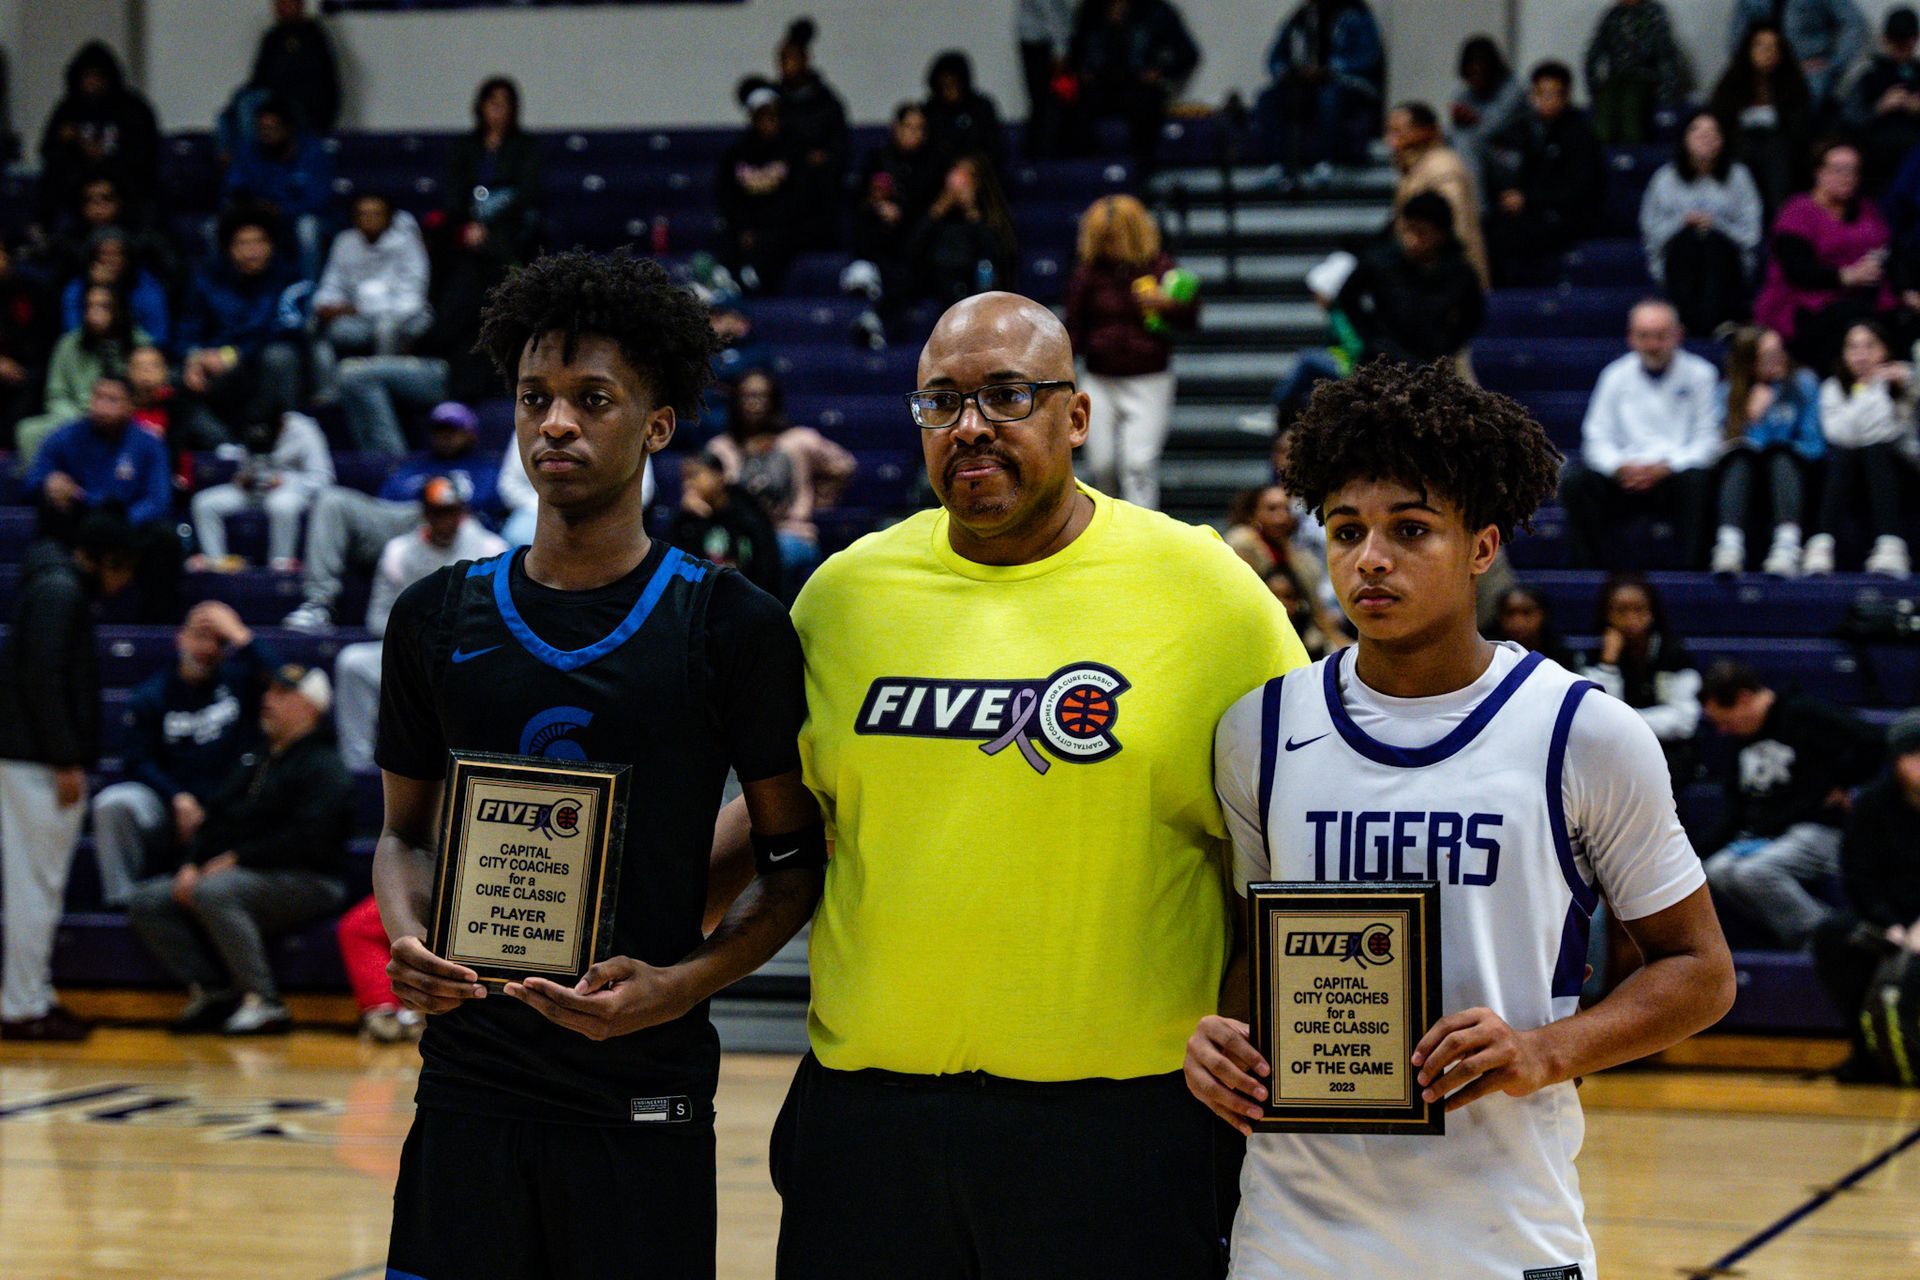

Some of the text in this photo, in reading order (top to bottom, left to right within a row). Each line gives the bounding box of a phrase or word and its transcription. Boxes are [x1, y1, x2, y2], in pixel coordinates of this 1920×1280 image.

[1062, 674, 1082, 686] CURE
[1082, 674, 1113, 688] CLASSIC
[1048, 690, 1058, 704] FOR
[865, 686, 1013, 731] FIVE
[1045, 704, 1058, 736] COACHES
[1056, 736, 1072, 747] CITY
[1074, 741, 1104, 750] CAPITAL
[480, 802, 537, 824] FIVE
[500, 844, 552, 859] CAPITAL
[1306, 811, 1504, 886] TIGERS
[479, 856, 570, 875] CITY COACHES
[509, 874, 535, 886] for a
[476, 884, 566, 903] CURE CLASSIC
[490, 906, 546, 923] PLAYER
[468, 921, 565, 942] OF THE GAME
[502, 944, 526, 955] 2023
[1289, 934, 1348, 954] FIVE
[1314, 977, 1368, 990] CAPITAL
[1294, 992, 1388, 1004] CITY COACHES
[1327, 1007, 1355, 1019] for a
[1294, 1022, 1389, 1034] CURE CLASSIC
[1313, 1044, 1370, 1056] PLAYER
[1291, 1061, 1393, 1075] OF THE GAME
[1329, 1082, 1355, 1092] 2023
[676, 1103, 685, 1115] S
